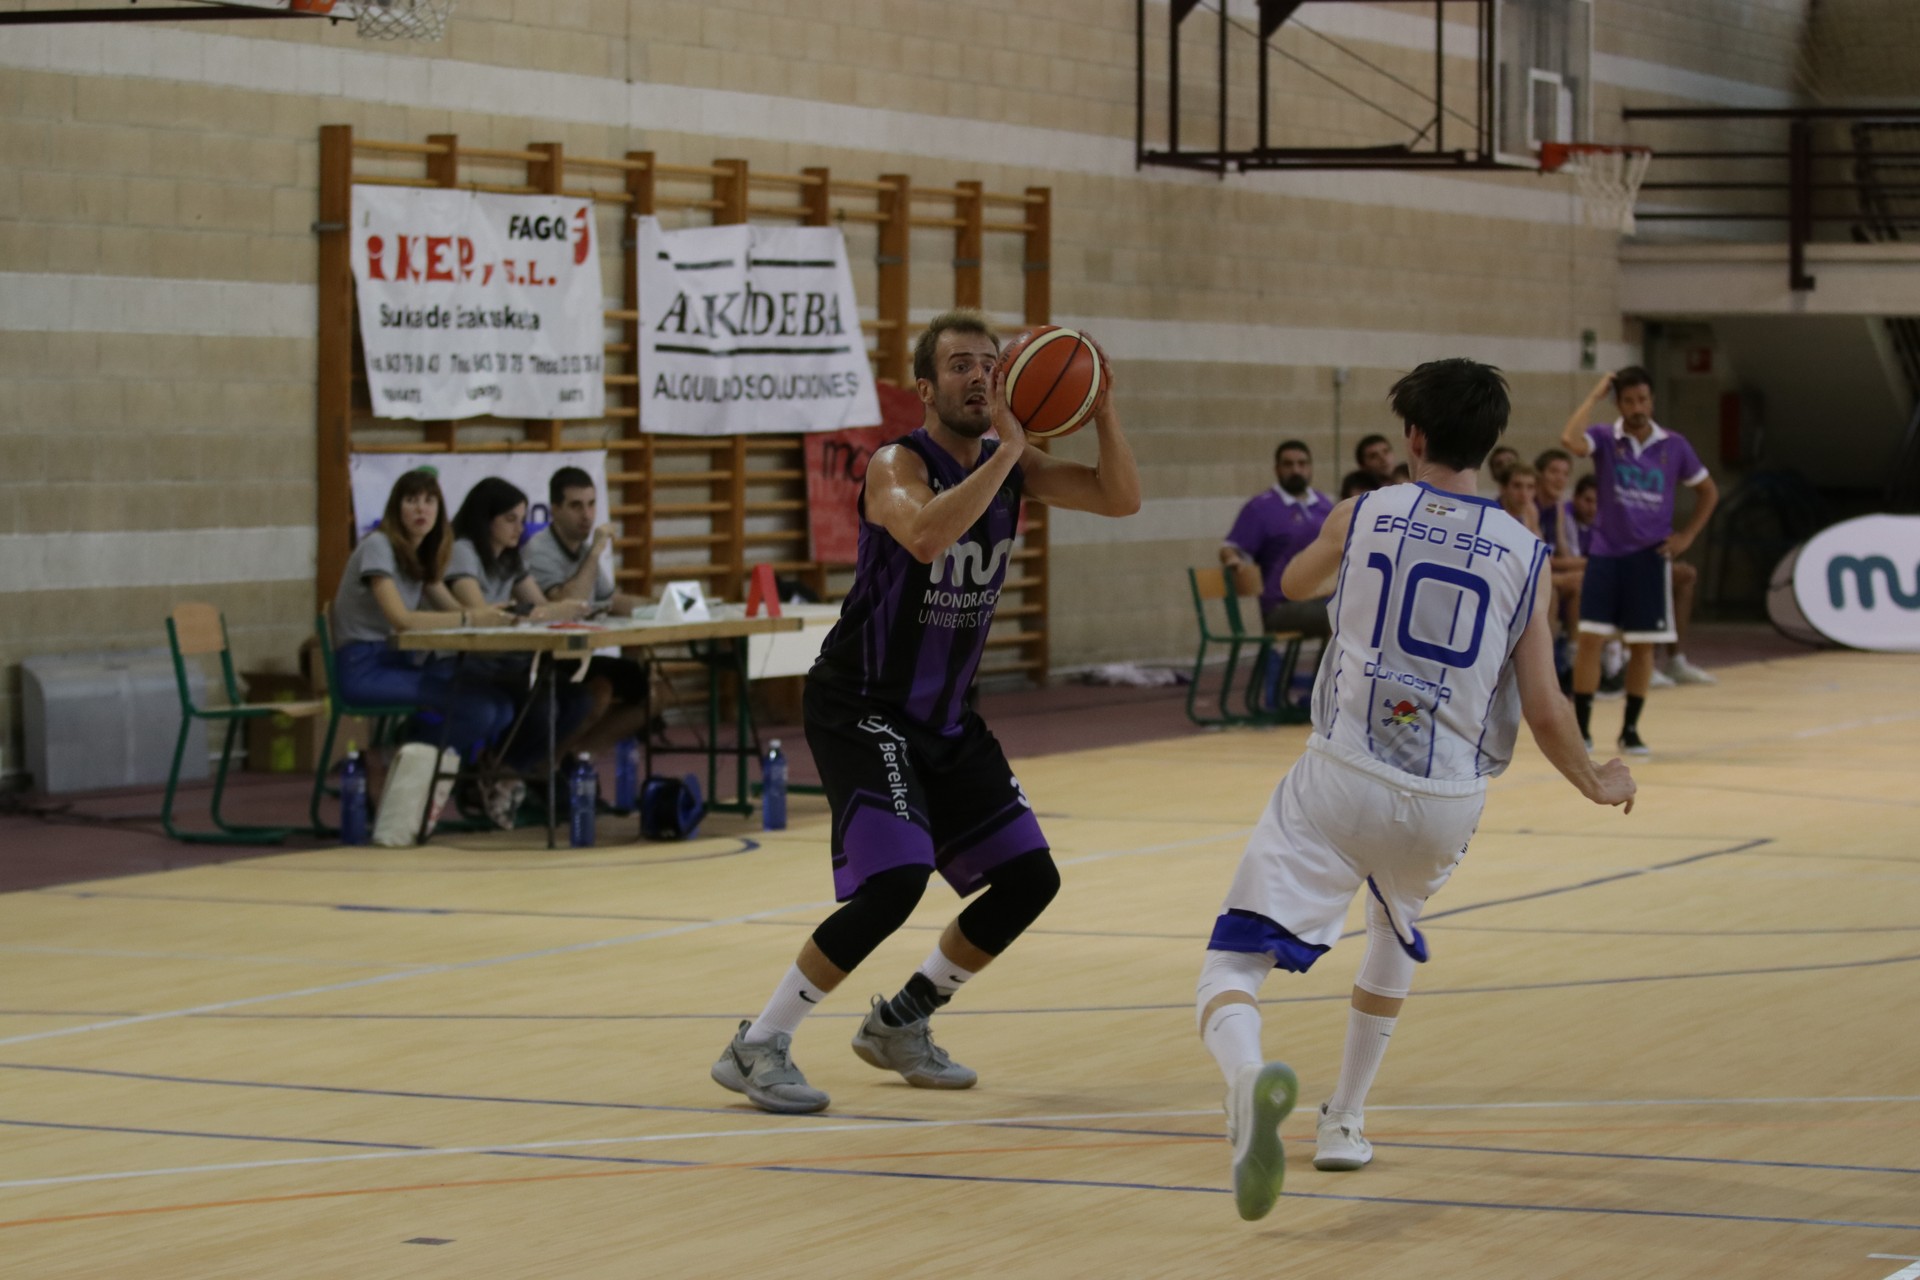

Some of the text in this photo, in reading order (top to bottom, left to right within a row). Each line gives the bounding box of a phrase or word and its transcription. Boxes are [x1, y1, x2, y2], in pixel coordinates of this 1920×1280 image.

[1373, 515, 1511, 563] EASO SBT
[1366, 552, 1491, 669] 10
[879, 742, 911, 821] Bereiker
